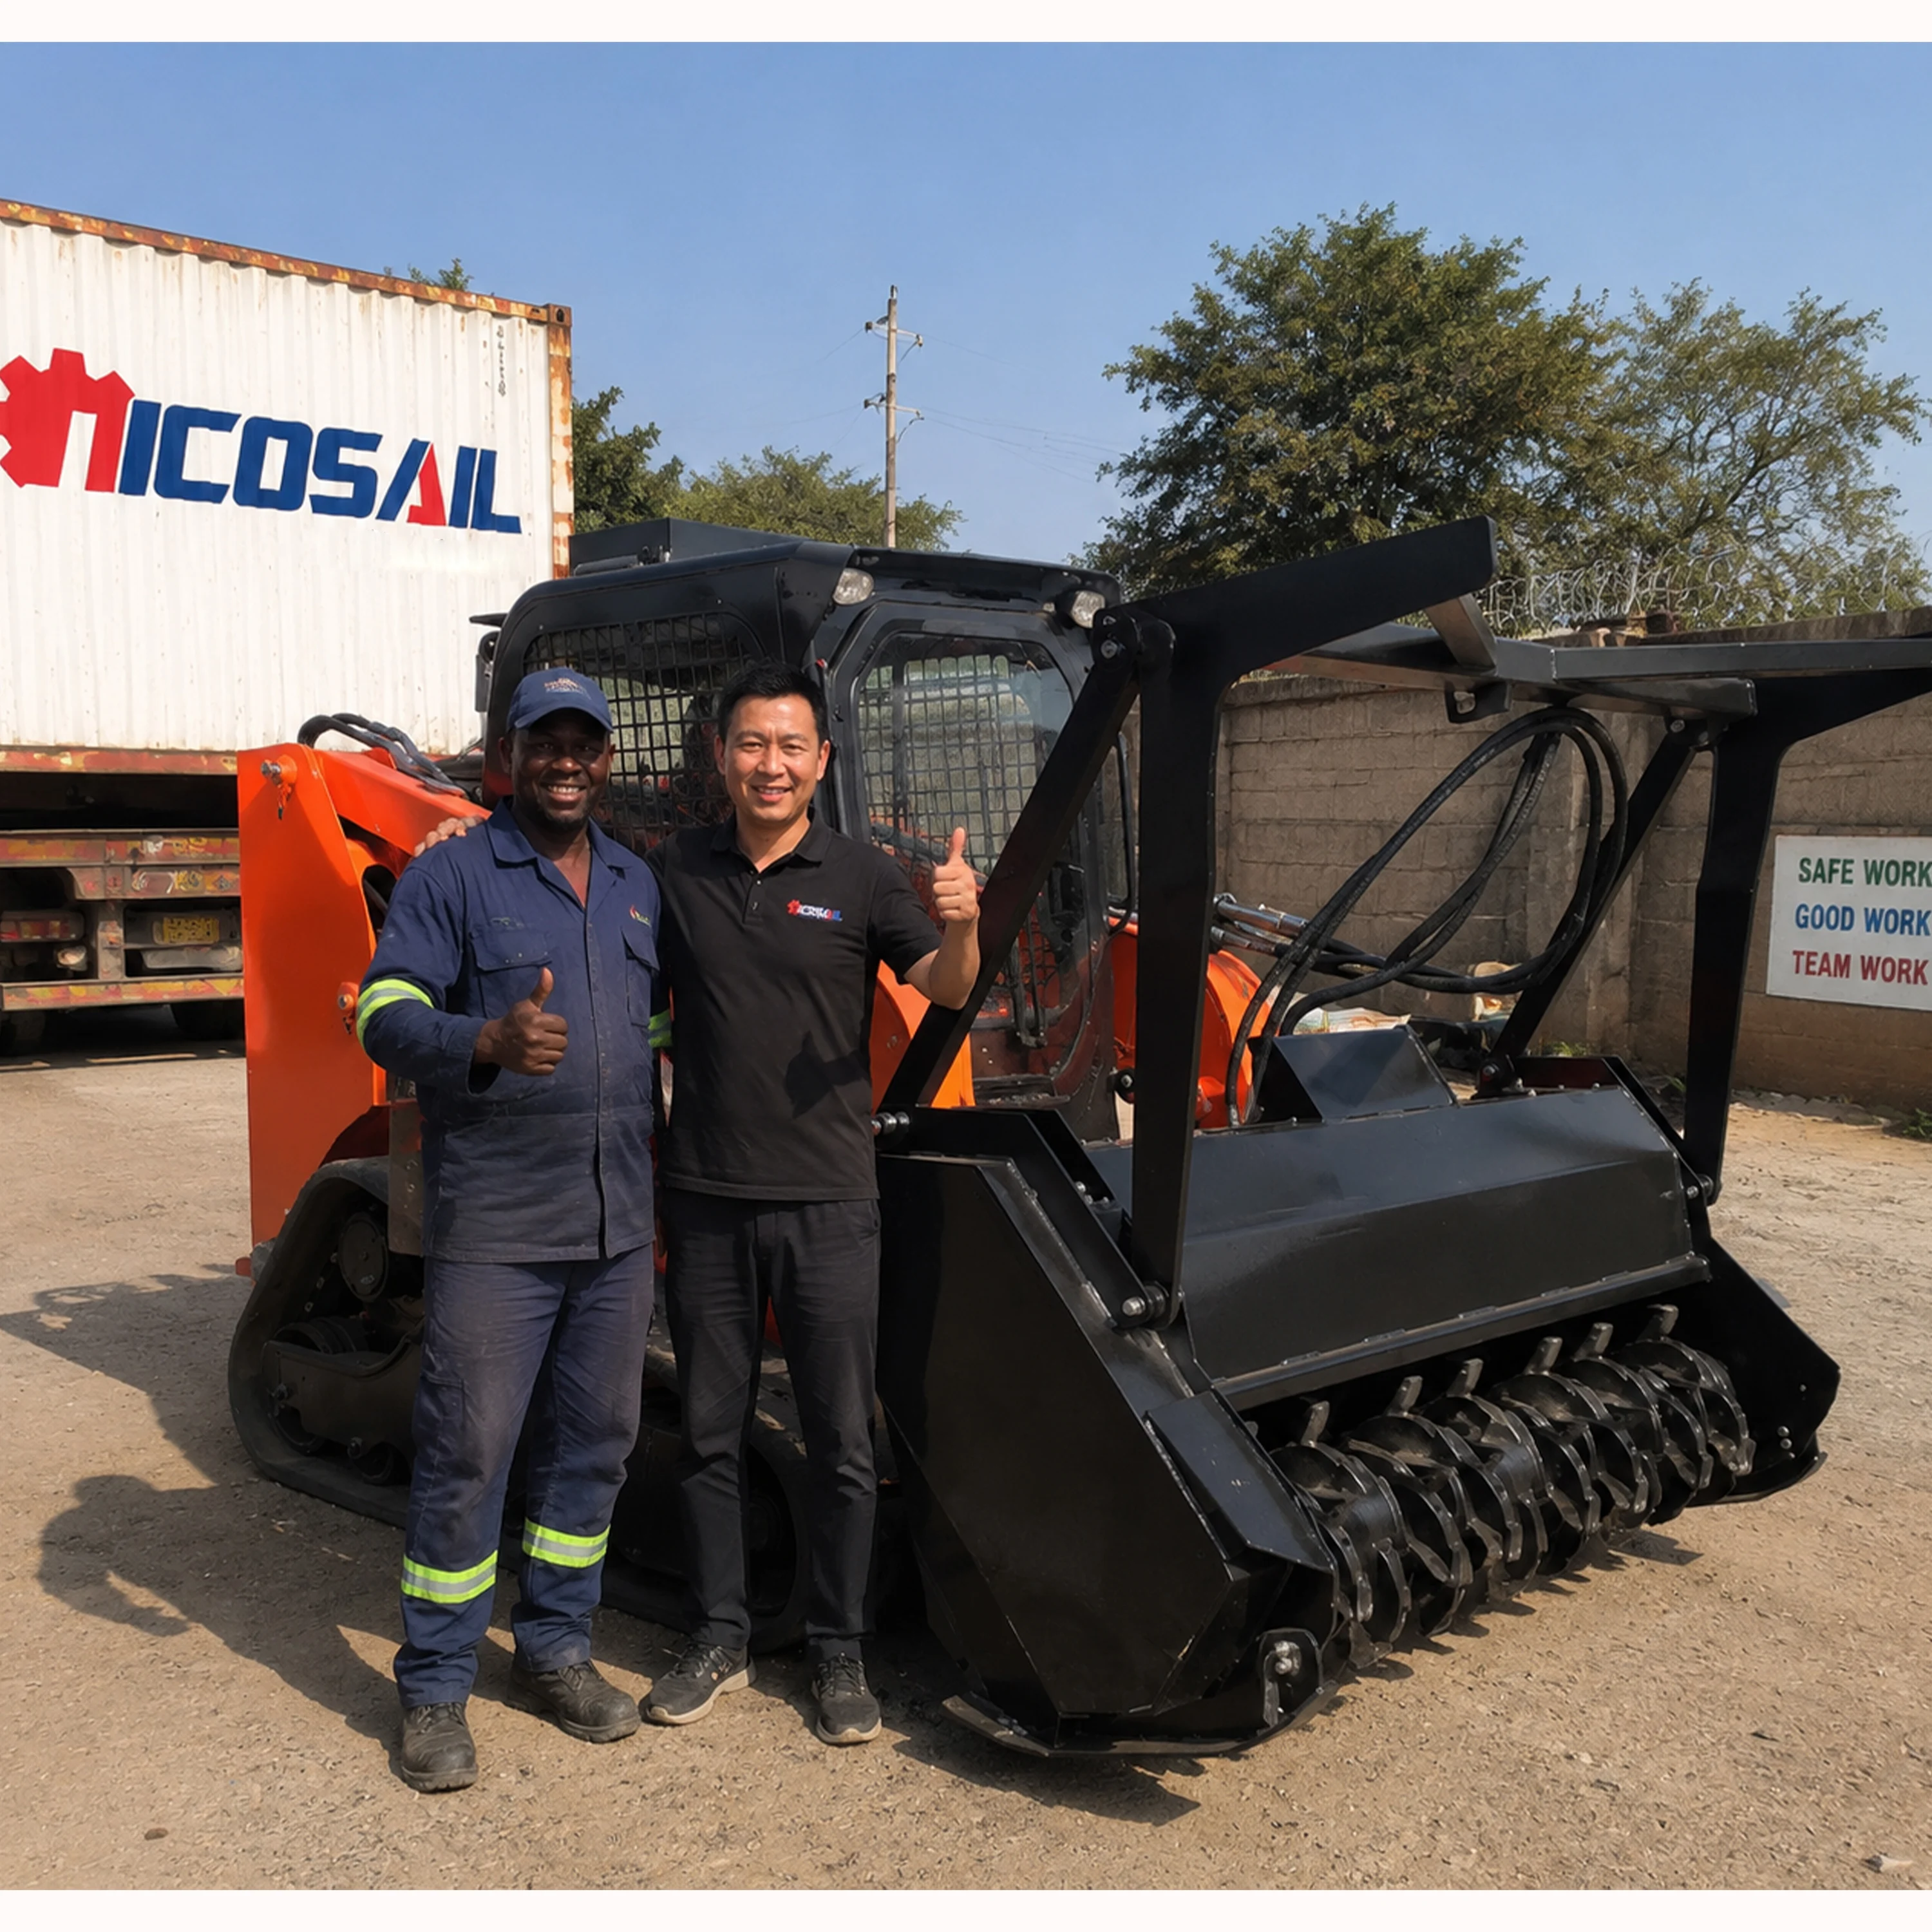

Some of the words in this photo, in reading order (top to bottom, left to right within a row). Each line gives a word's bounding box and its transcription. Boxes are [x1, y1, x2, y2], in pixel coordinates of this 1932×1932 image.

[1798, 857, 1855, 884] SAFE
[1863, 858, 1932, 887] WORK
[1795, 904, 1855, 931] GOOD
[1863, 907, 1932, 937] WORK
[1792, 950, 1852, 978] TEAM
[1860, 955, 1929, 985] WORK
